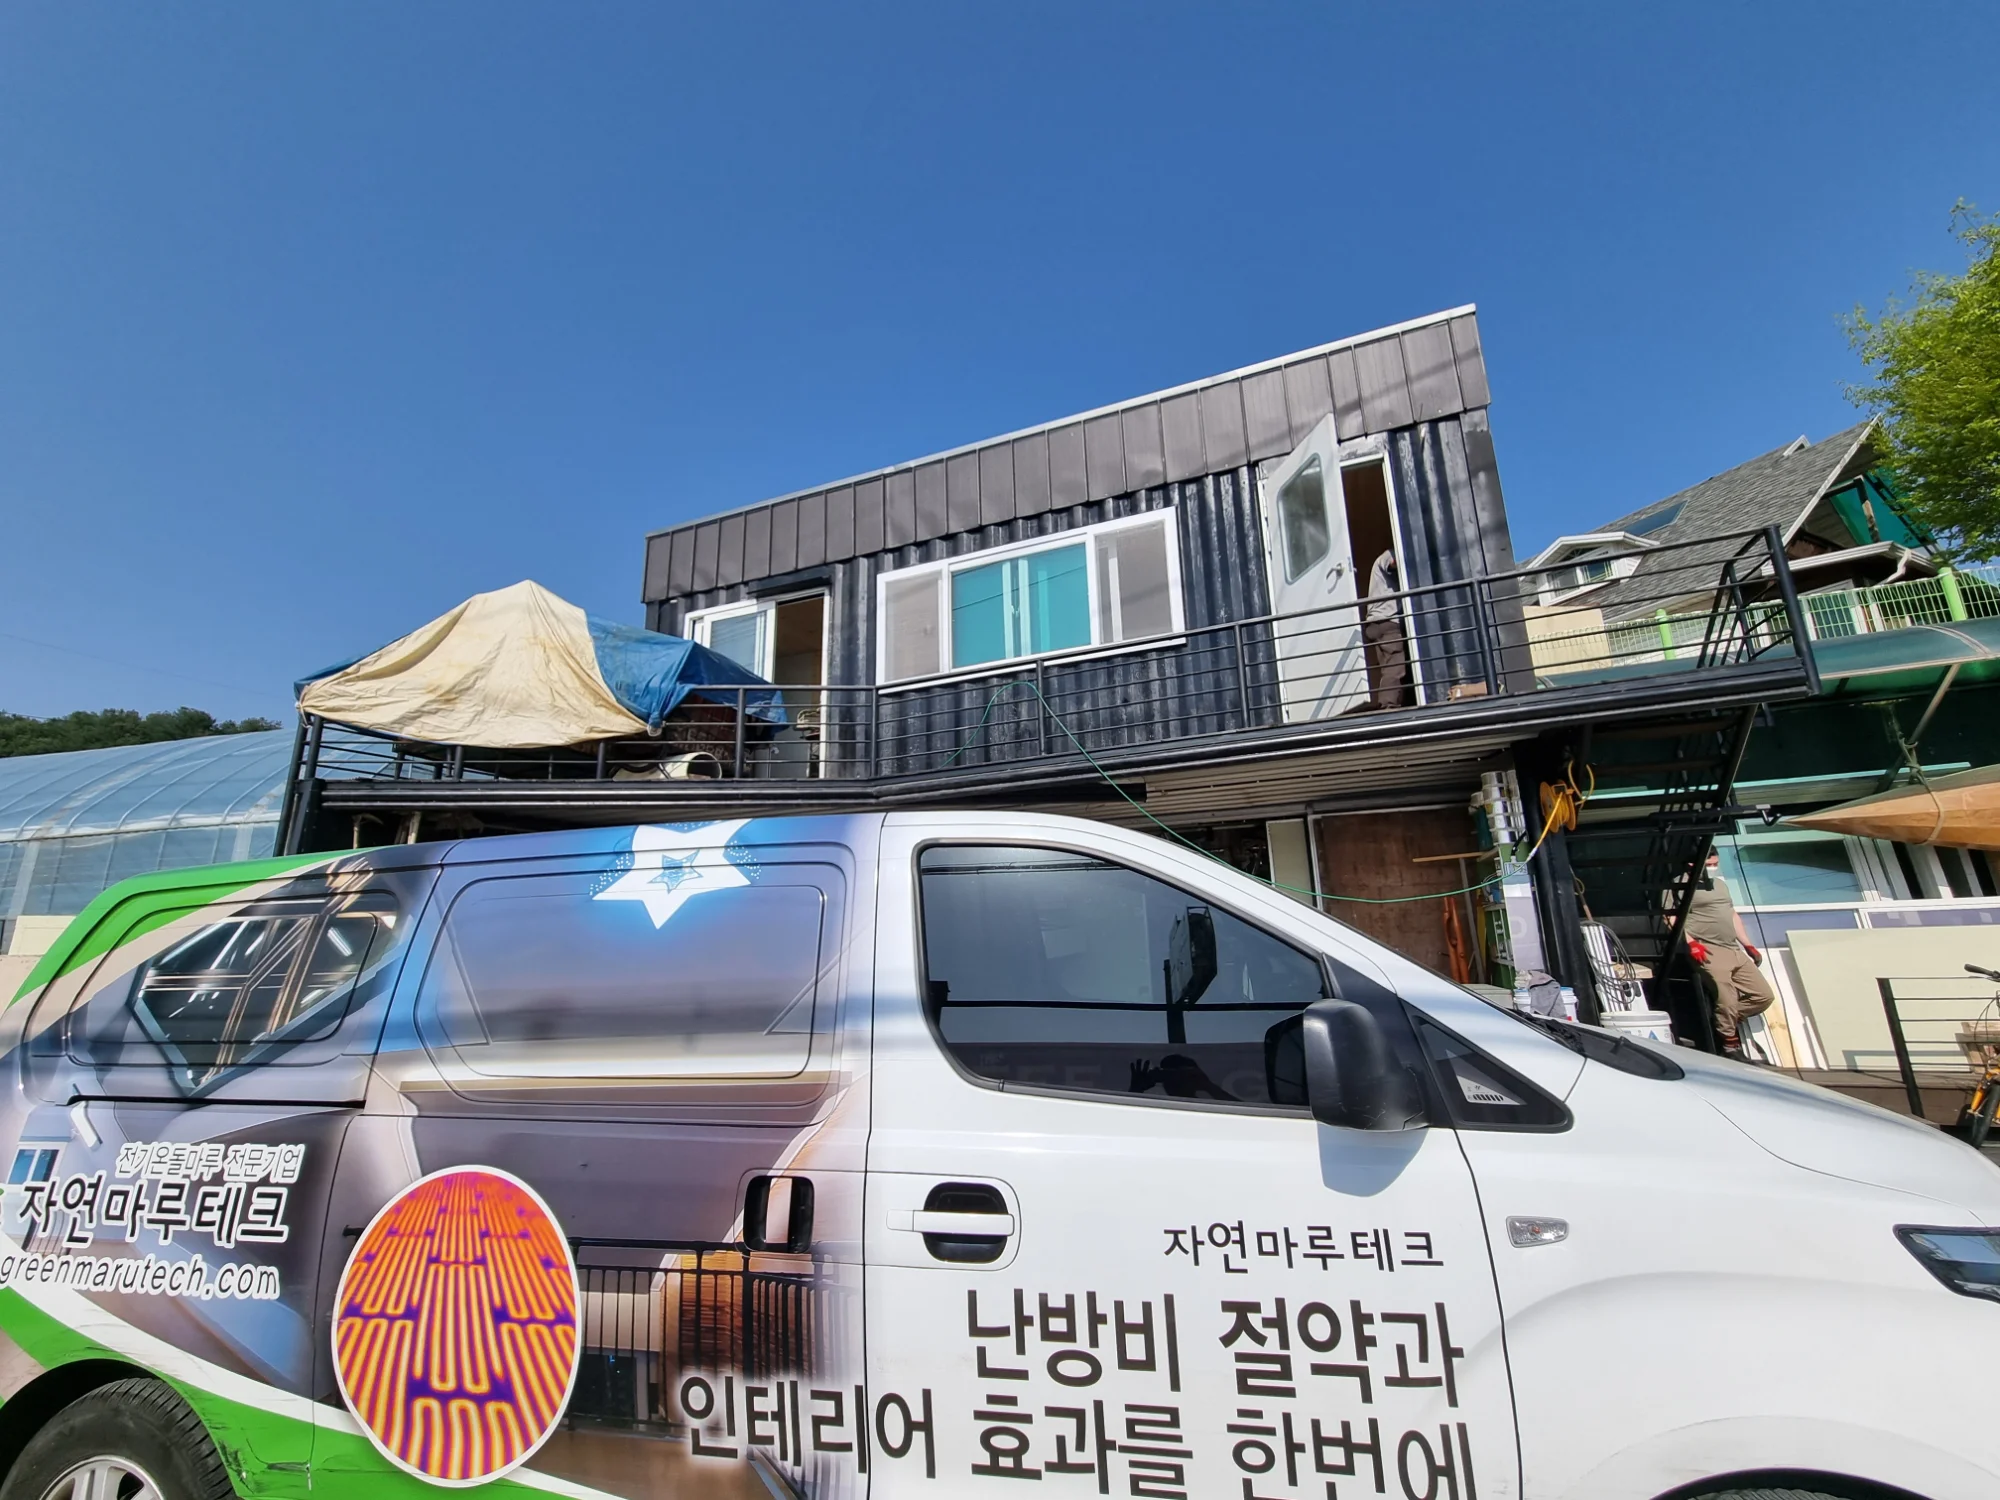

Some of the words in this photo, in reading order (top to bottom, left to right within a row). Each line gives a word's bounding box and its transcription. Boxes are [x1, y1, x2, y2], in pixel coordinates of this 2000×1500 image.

[118, 1145, 222, 1178] 전기온돌마루
[226, 1147, 301, 1179] 전문기업
[18, 1174, 285, 1244] 자연마루테크
[0, 1254, 278, 1295] greenmarutech.com
[1163, 1220, 1445, 1274] 자연마루테크
[966, 1288, 1181, 1393] 난방비
[1218, 1298, 1465, 1408] 절약과
[680, 1375, 936, 1479] 인테리어
[971, 1393, 1194, 1500] 효과를
[1226, 1408, 1478, 1500] 한번에
